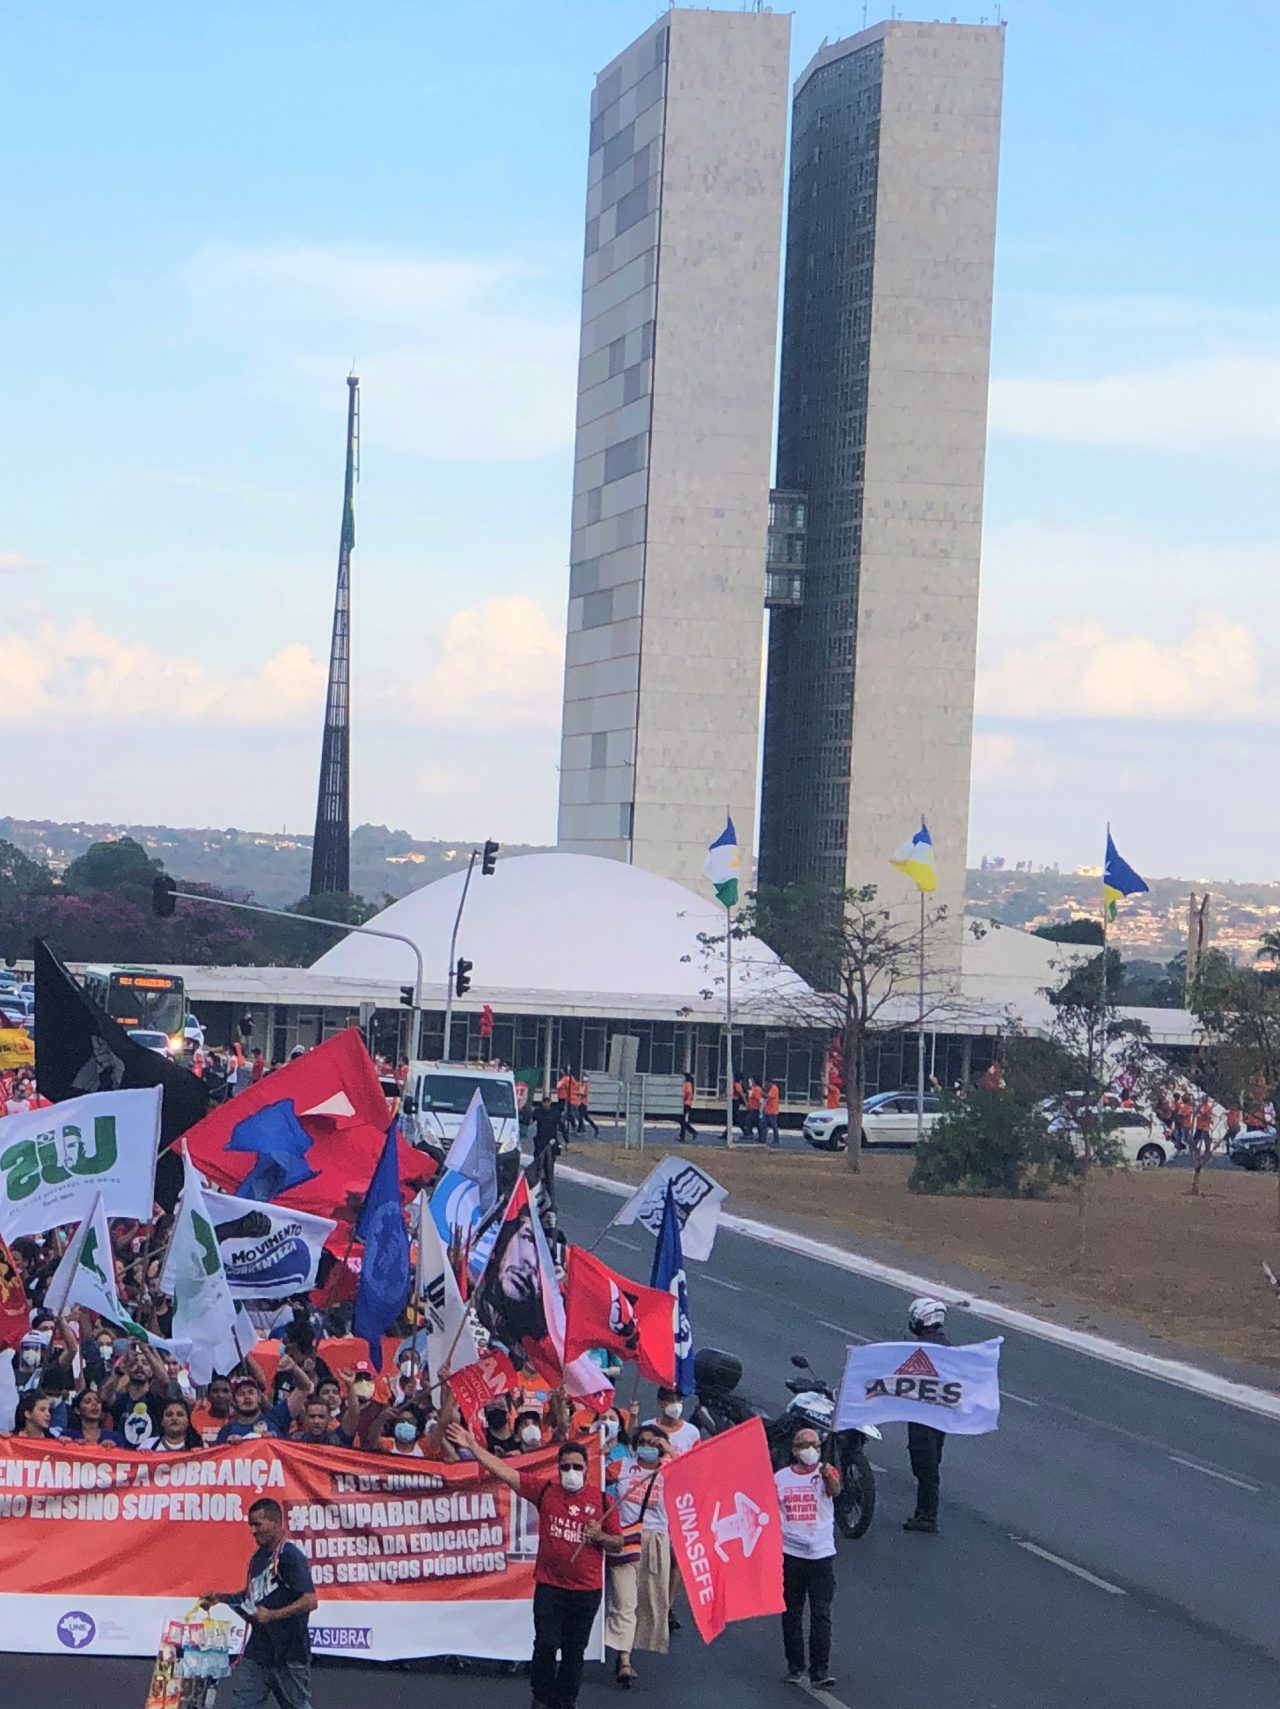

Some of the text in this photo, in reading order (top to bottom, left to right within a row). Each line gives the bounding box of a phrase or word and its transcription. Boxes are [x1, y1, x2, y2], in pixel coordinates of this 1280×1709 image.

[225, 1240, 298, 1275] CORRENTEZA
[231, 1223, 303, 1265] MOVIMENTO
[865, 1377, 963, 1405] APES
[116, 1463, 131, 1487] E
[135, 1464, 151, 1487] A
[154, 1458, 286, 1493] COBRANÇA
[335, 1474, 357, 1493] 14
[358, 1474, 381, 1492] DE
[30, 1492, 120, 1520] ENSINO
[122, 1492, 248, 1522] SUPERIOR.
[287, 1491, 497, 1532] #OCUPABRASÍLIA
[315, 1534, 381, 1559] DEFESA
[383, 1533, 408, 1556] DA
[410, 1524, 503, 1554] EDUCAÇÃO
[675, 1492, 715, 1606] SINASEFE
[336, 1560, 421, 1585] SERVIÇOS
[423, 1552, 507, 1578] PÚBLICOS
[69, 1623, 87, 1632] UNE
[308, 1628, 368, 1646] FASUBRA
